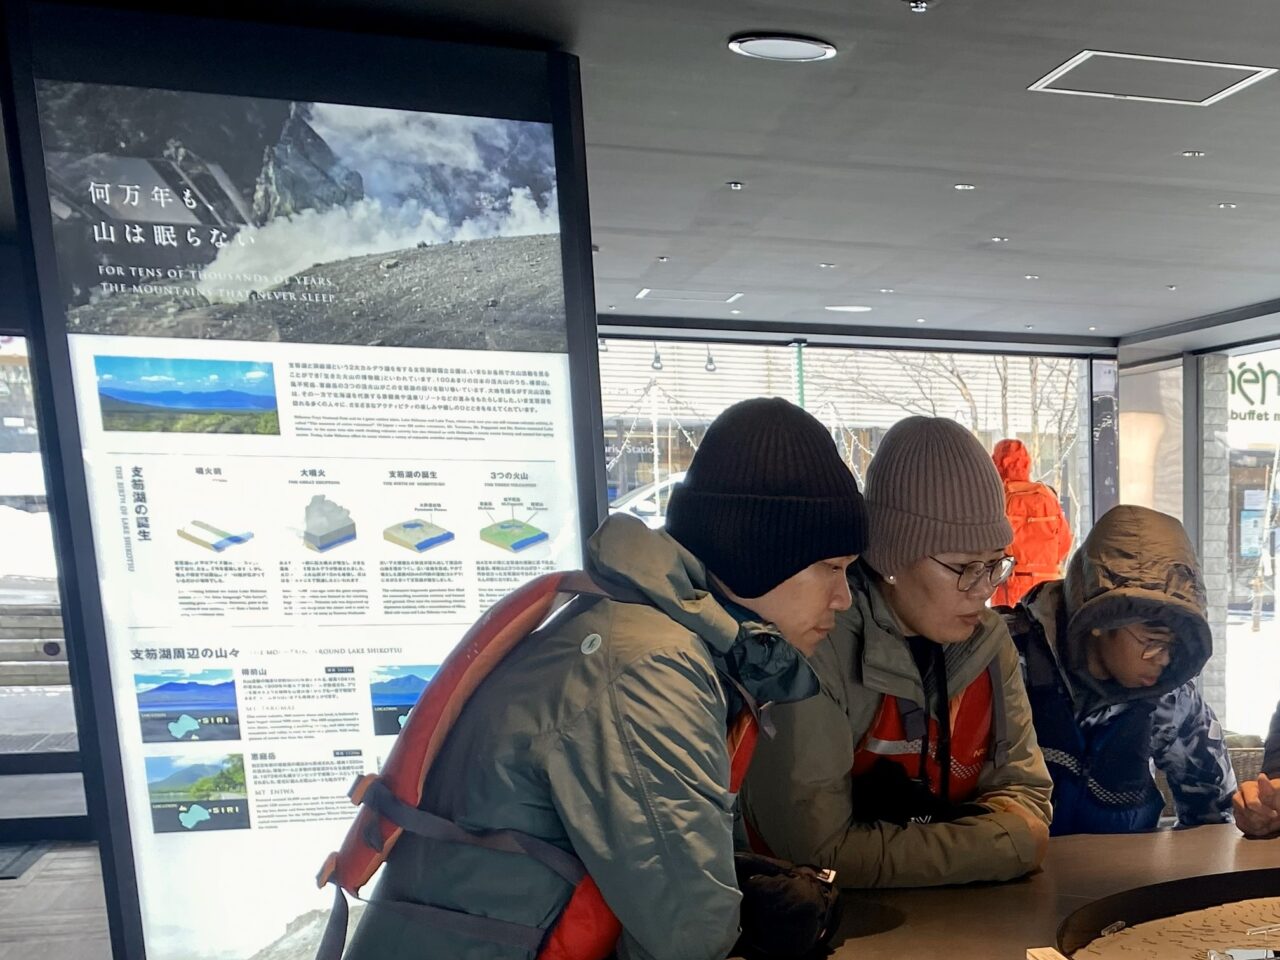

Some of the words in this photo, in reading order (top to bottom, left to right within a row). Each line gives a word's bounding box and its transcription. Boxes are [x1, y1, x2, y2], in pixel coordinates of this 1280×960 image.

[88, 182, 214, 210] 何万年も、
[93, 222, 255, 247] 山は眠らない
[98, 265, 125, 276] FOR
[129, 267, 162, 277] TENS
[167, 269, 184, 279] OF
[190, 270, 268, 282] THOUSANDS
[100, 282, 126, 292] THE
[132, 284, 212, 297] MOUNTAINS
[257, 291, 296, 301] NEVER
[1230, 409, 1270, 421] buffet
[490, 471, 529, 480] 3つの火山
[130, 647, 241, 660] 支笏湖周辺の山々
[203, 716, 229, 724] SIRI
[212, 806, 239, 814] SIRI
